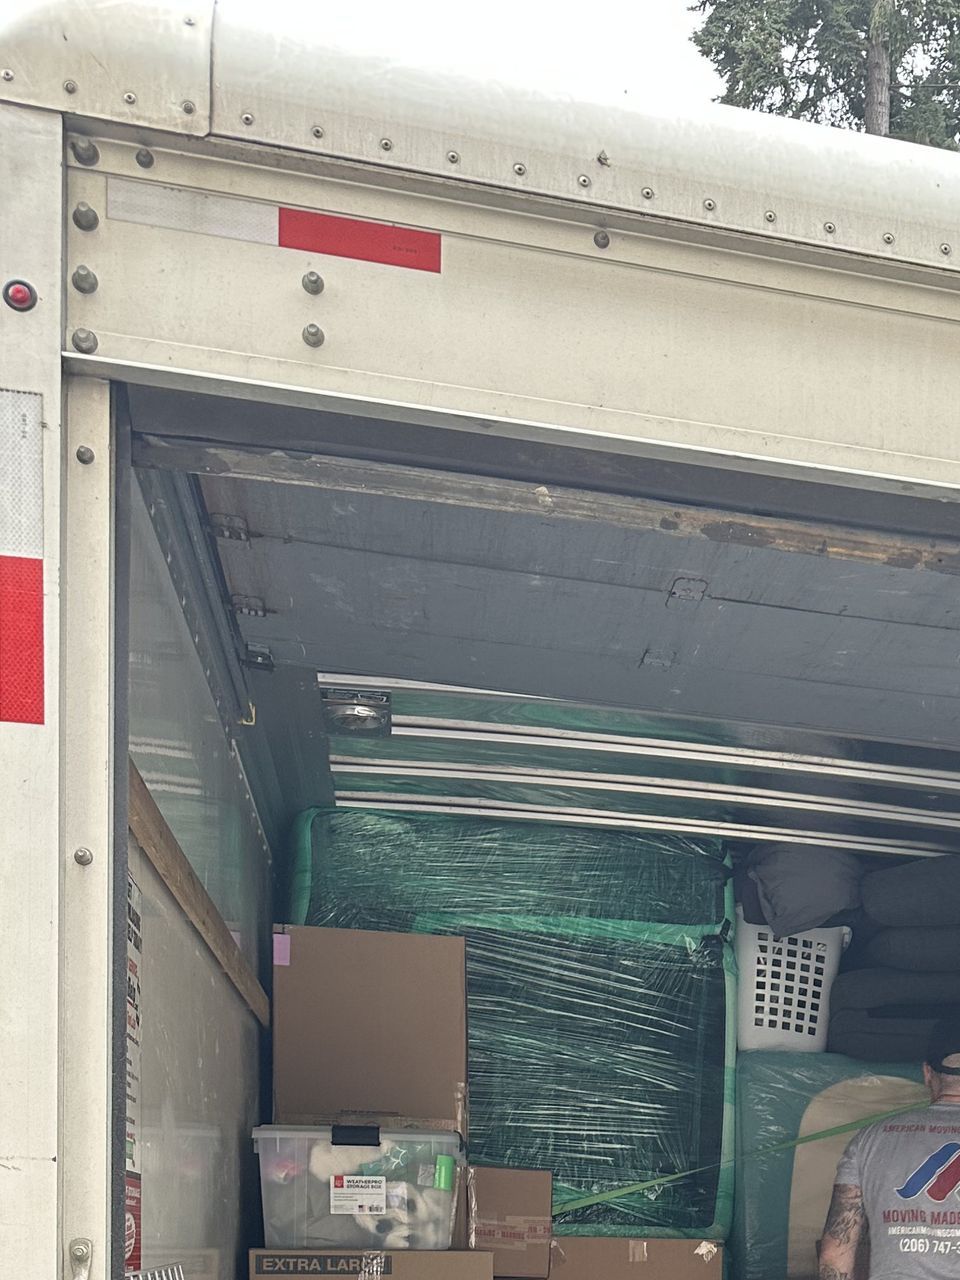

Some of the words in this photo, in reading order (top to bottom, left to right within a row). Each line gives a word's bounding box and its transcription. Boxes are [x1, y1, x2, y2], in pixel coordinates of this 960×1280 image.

[883, 1124, 926, 1134] AMERICAN
[882, 1210, 927, 1224] MOVING
[899, 1238, 930, 1254] (206)
[262, 1258, 321, 1272] EXTRA
[326, 1257, 386, 1272] LARG
